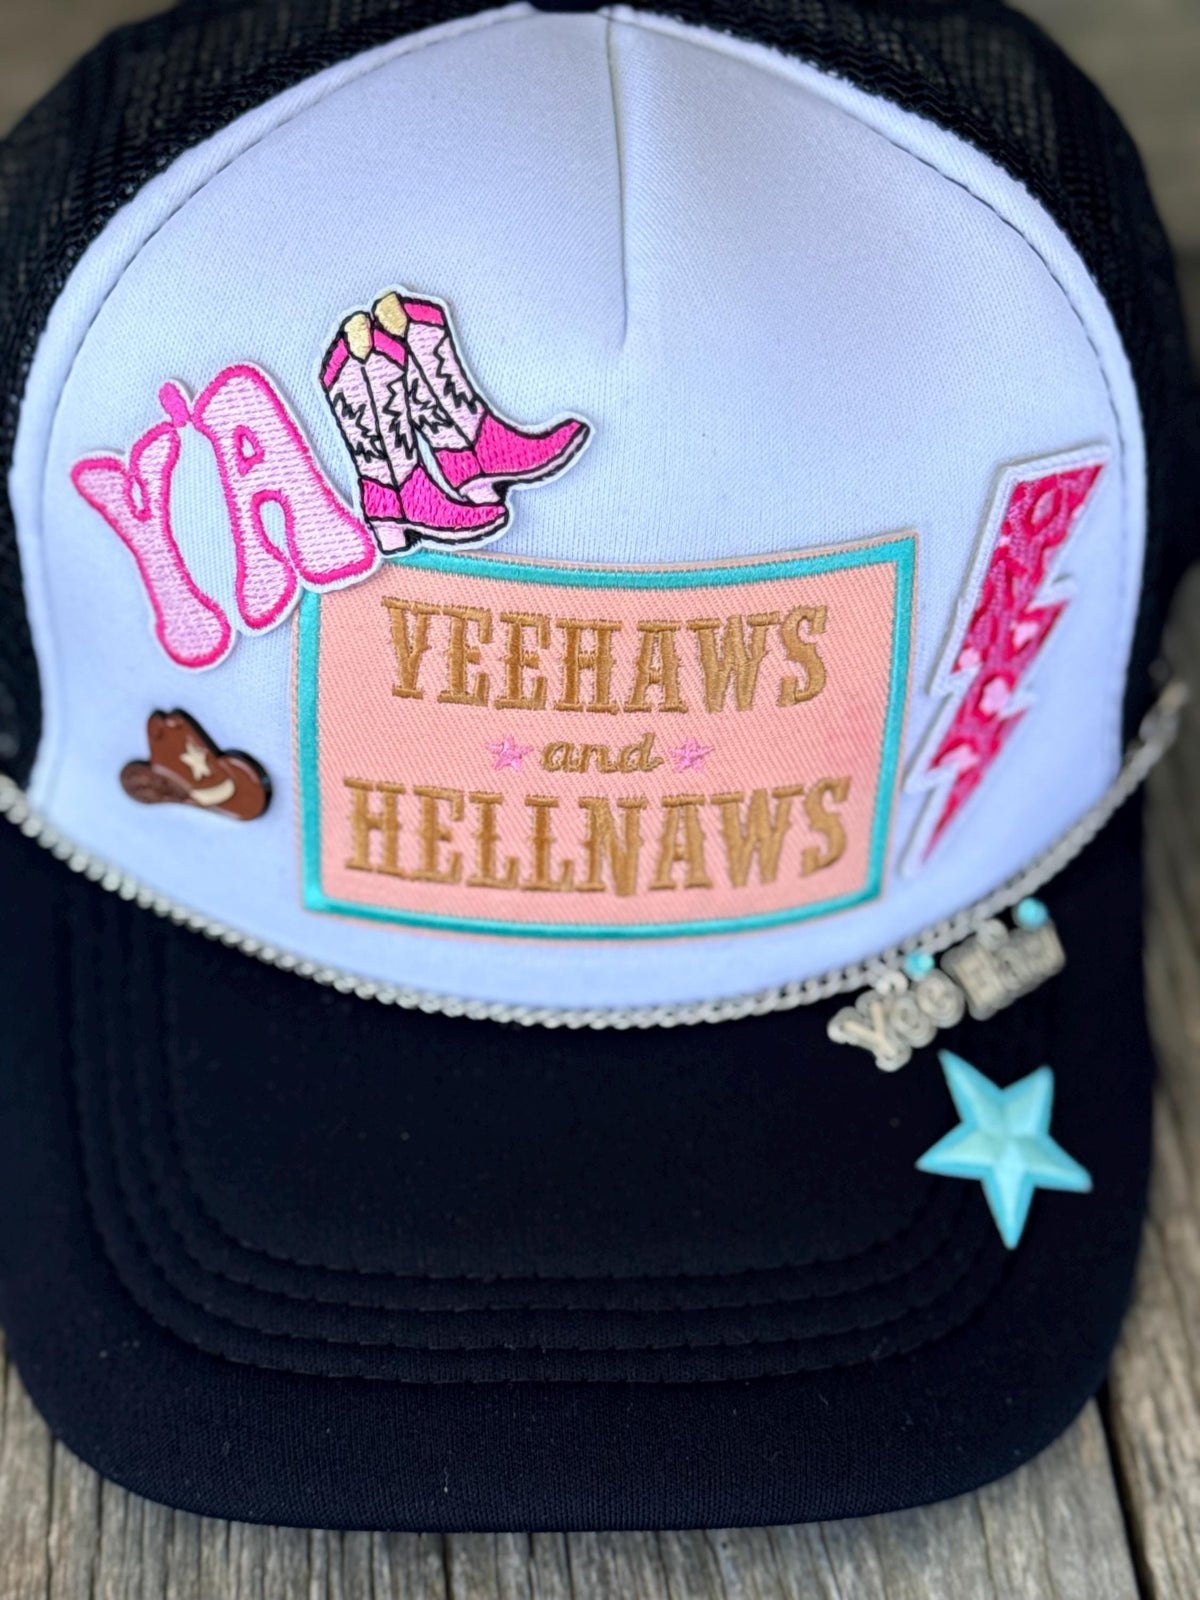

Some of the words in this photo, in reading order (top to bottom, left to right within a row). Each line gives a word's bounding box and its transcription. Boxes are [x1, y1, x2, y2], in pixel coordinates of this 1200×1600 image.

[382, 597, 828, 714] YEEHAWS
[540, 733, 664, 773] and
[343, 777, 851, 896] HELLNAWS
